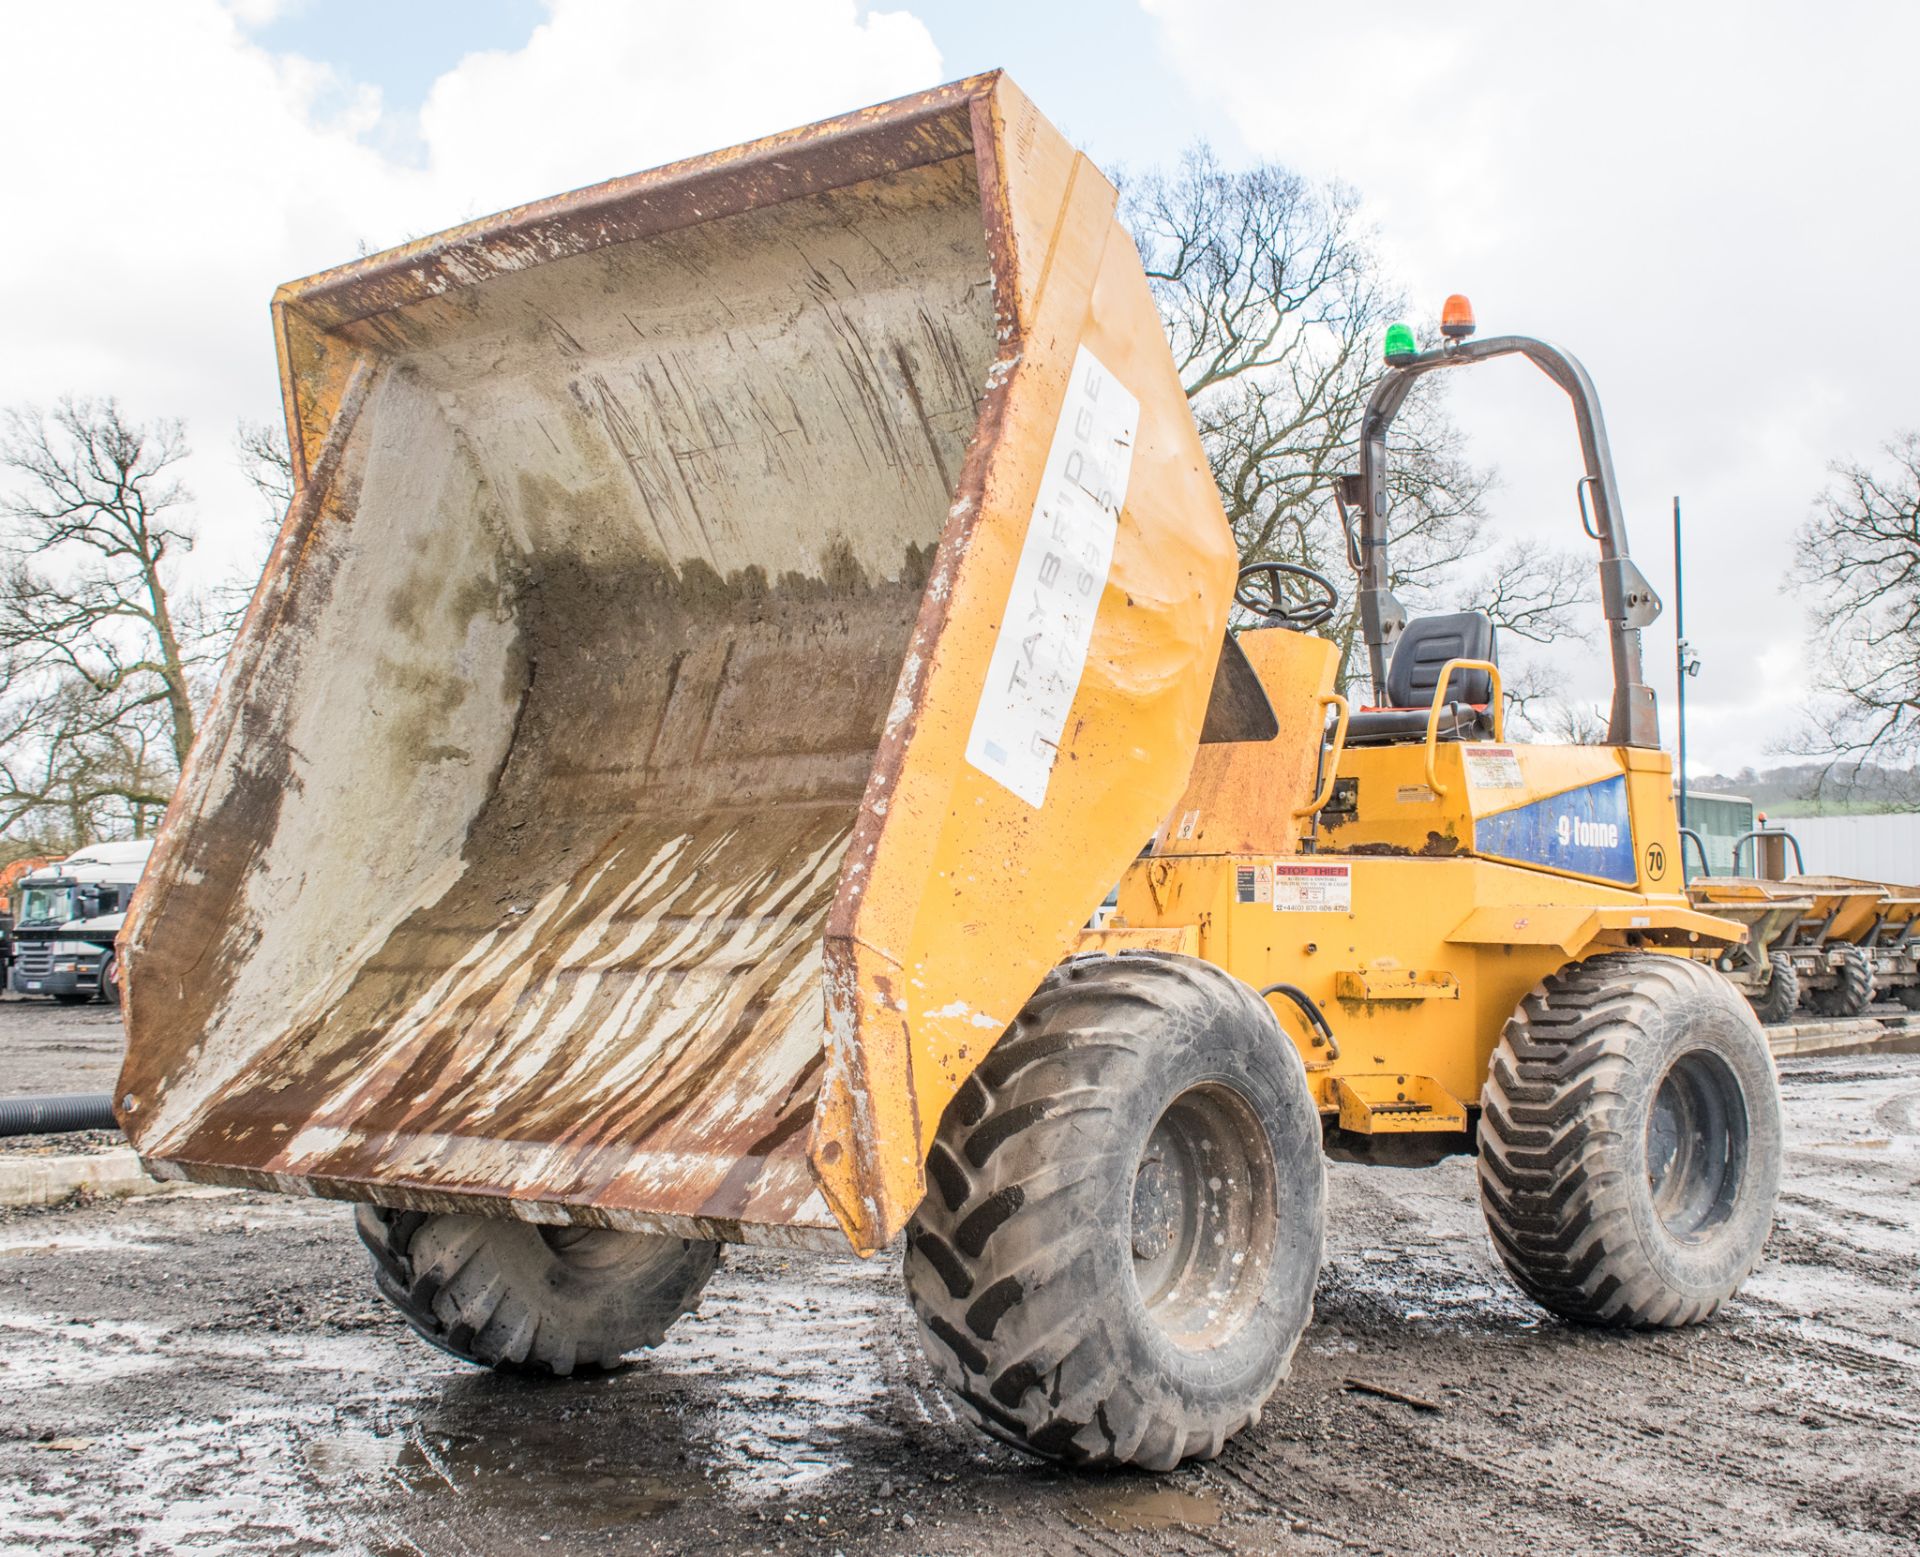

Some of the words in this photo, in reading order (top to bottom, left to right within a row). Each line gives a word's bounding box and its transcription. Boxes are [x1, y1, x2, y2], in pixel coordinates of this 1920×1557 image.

[1558, 815, 1570, 846] 9
[1574, 815, 1618, 848] tonne
[1648, 851, 1663, 871] 70
[1278, 867, 1308, 876] STOP
[1312, 867, 1348, 877] THIEF!
